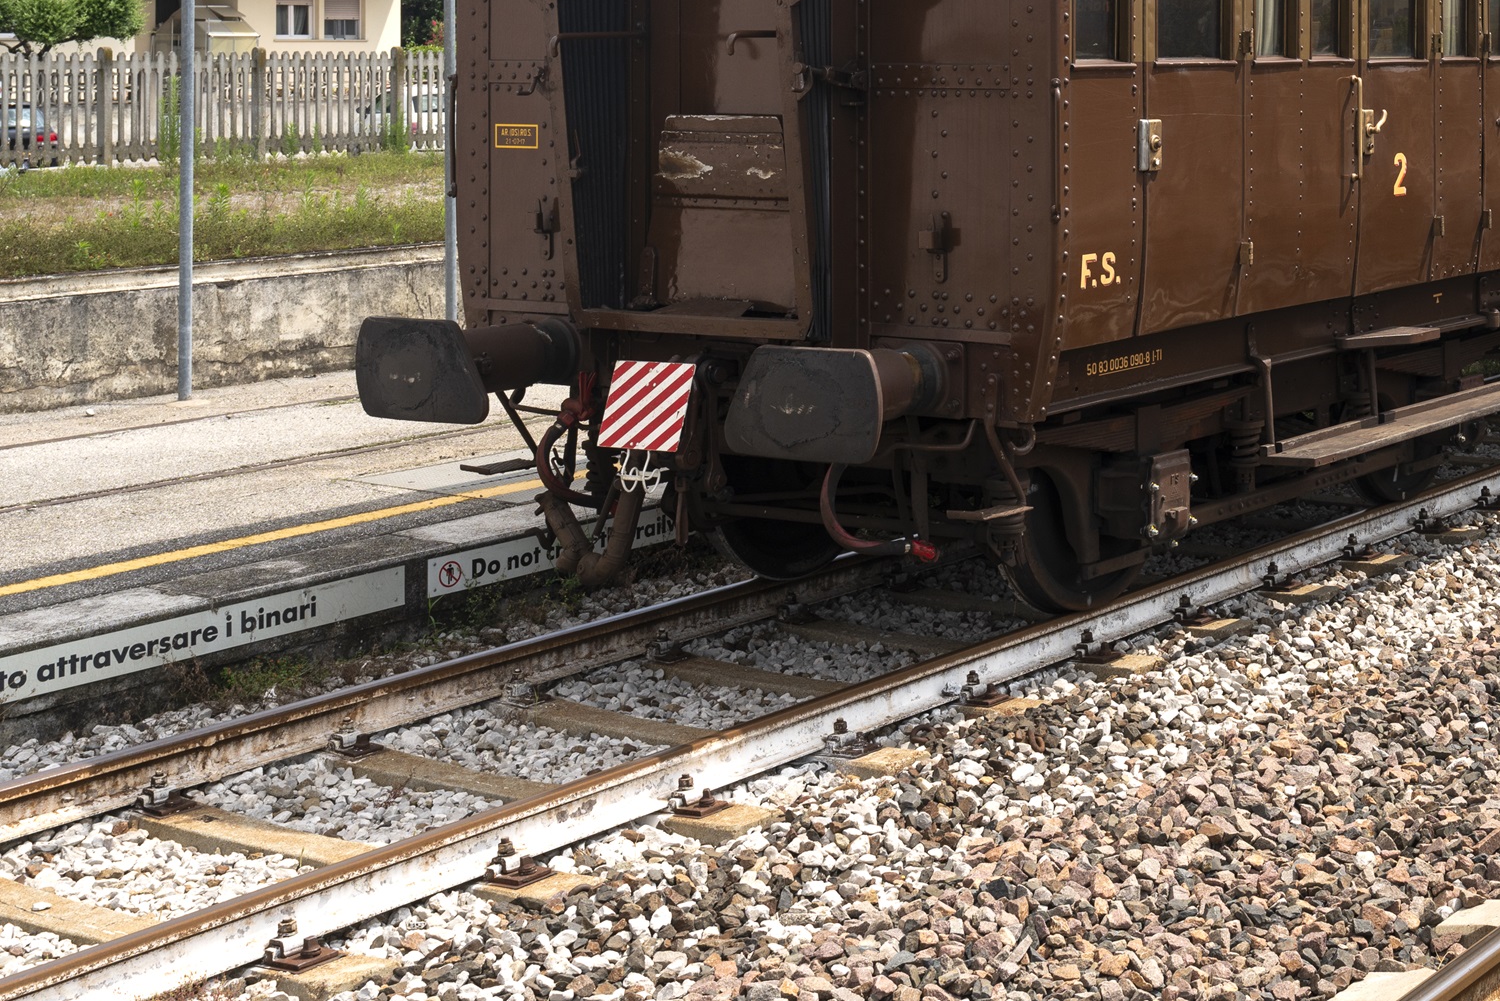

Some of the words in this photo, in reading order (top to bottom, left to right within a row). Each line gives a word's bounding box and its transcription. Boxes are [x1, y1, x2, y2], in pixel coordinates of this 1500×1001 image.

[1393, 152, 1408, 197] 2
[1080, 251, 1121, 290] F.S.
[1086, 363, 1097, 376] 50
[1098, 358, 1109, 374] 83
[1109, 355, 1129, 371] 0036
[471, 557, 501, 580] Do
[507, 546, 542, 571] not
[36, 624, 219, 683] attraversare
[225, 614, 233, 638] i
[240, 595, 318, 635] binari
